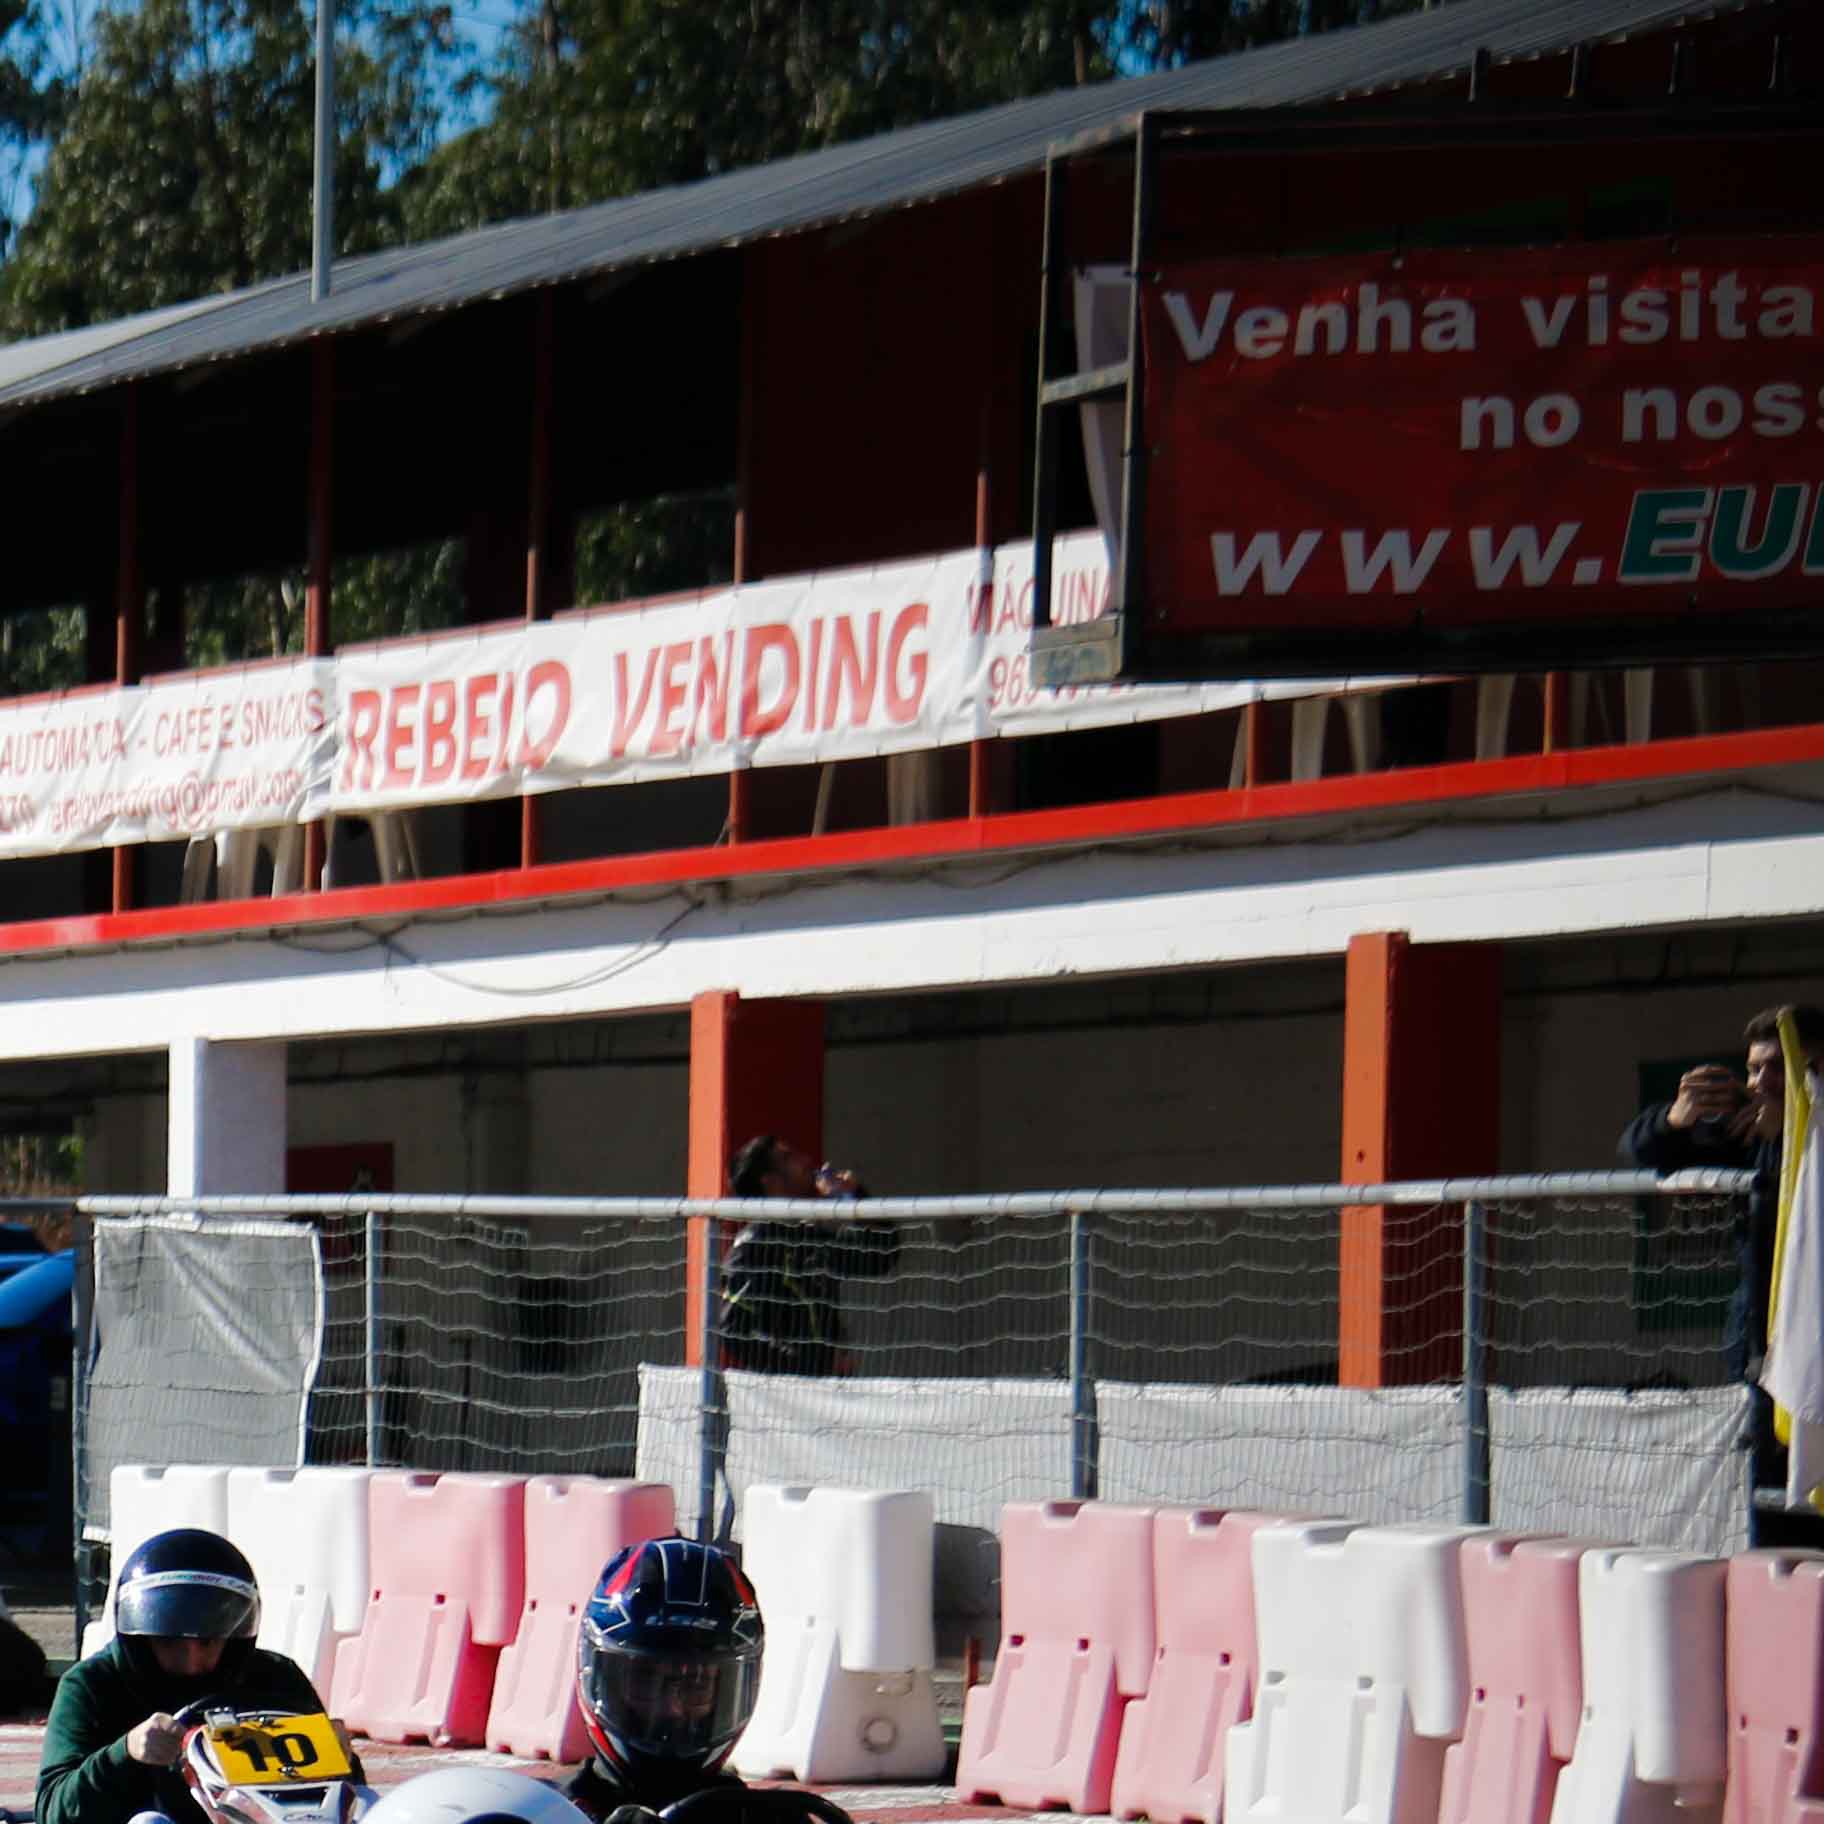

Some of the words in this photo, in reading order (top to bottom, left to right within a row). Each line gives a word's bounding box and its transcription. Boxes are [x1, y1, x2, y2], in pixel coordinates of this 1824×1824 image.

[1163, 283, 1476, 362] Venha
[1459, 391, 1583, 450] no
[610, 603, 929, 758] VENDING
[241, 1733, 319, 1772] 10
